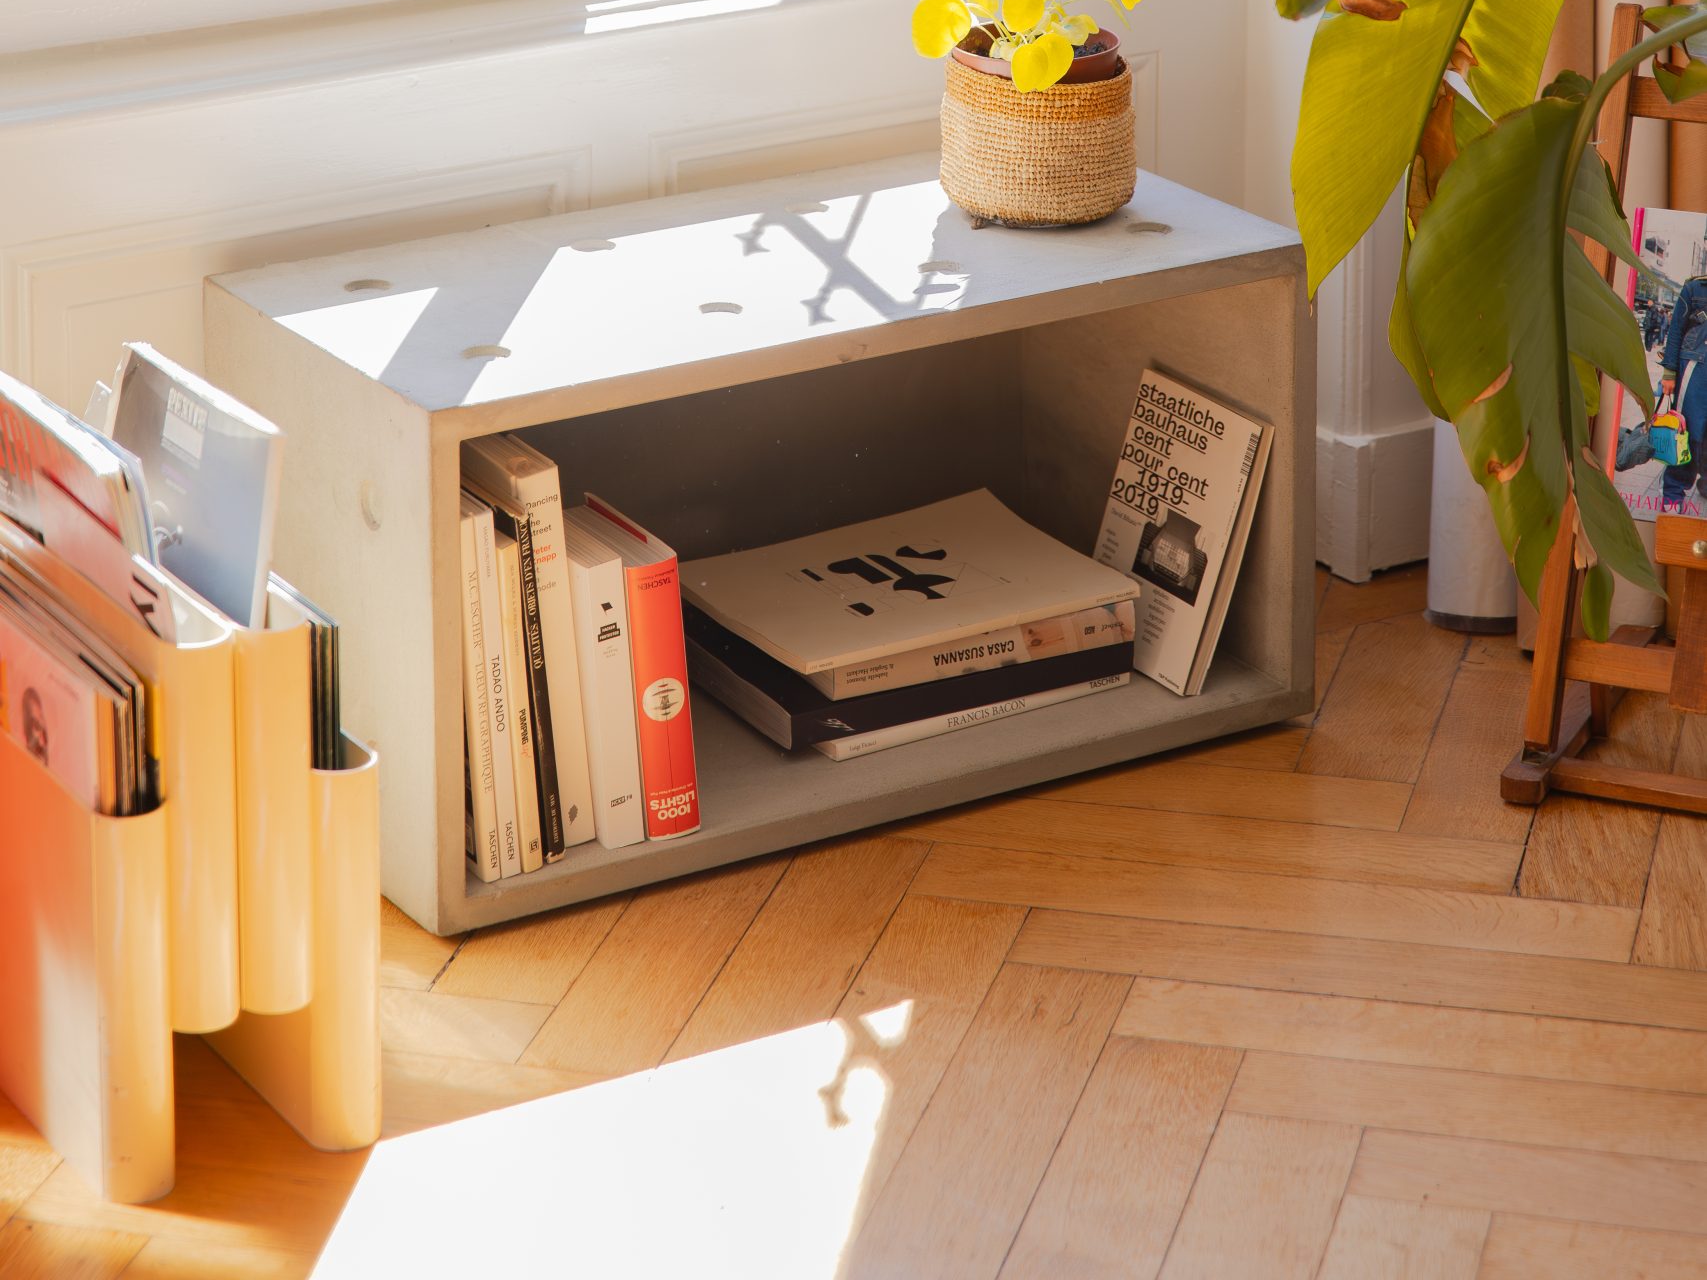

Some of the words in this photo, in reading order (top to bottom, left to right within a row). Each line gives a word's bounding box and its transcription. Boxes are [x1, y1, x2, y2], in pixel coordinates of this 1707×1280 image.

[1133, 397, 1209, 452] bauhaus
[1138, 382, 1225, 437] staatliche
[1133, 425, 1174, 457] cent
[1121, 441, 1163, 472] pour
[1167, 464, 1209, 498] cent
[1112, 477, 1160, 517] 2019
[1134, 469, 1190, 508] 1919-
[531, 524, 552, 537] treet
[533, 544, 551, 555] eter
[538, 580, 557, 592] ode
[637, 577, 672, 592] TASCHEN
[933, 644, 984, 667] SUSANNA
[987, 639, 1015, 656] CASA
[491, 655, 503, 695] TADAO
[1089, 673, 1121, 689] TASCHEN
[470, 599, 482, 649] ESCHER
[478, 719, 493, 793] GRAPHIQUE
[947, 708, 990, 728] FRANCIS
[992, 698, 1026, 716] BACON
[495, 697, 505, 733] ANDO
[518, 708, 529, 745] PUMPING
[649, 789, 695, 811] LIGHTS
[657, 803, 691, 821] 1000
[488, 829, 498, 869] TASCHEN
[505, 820, 514, 861] TASCHEN
